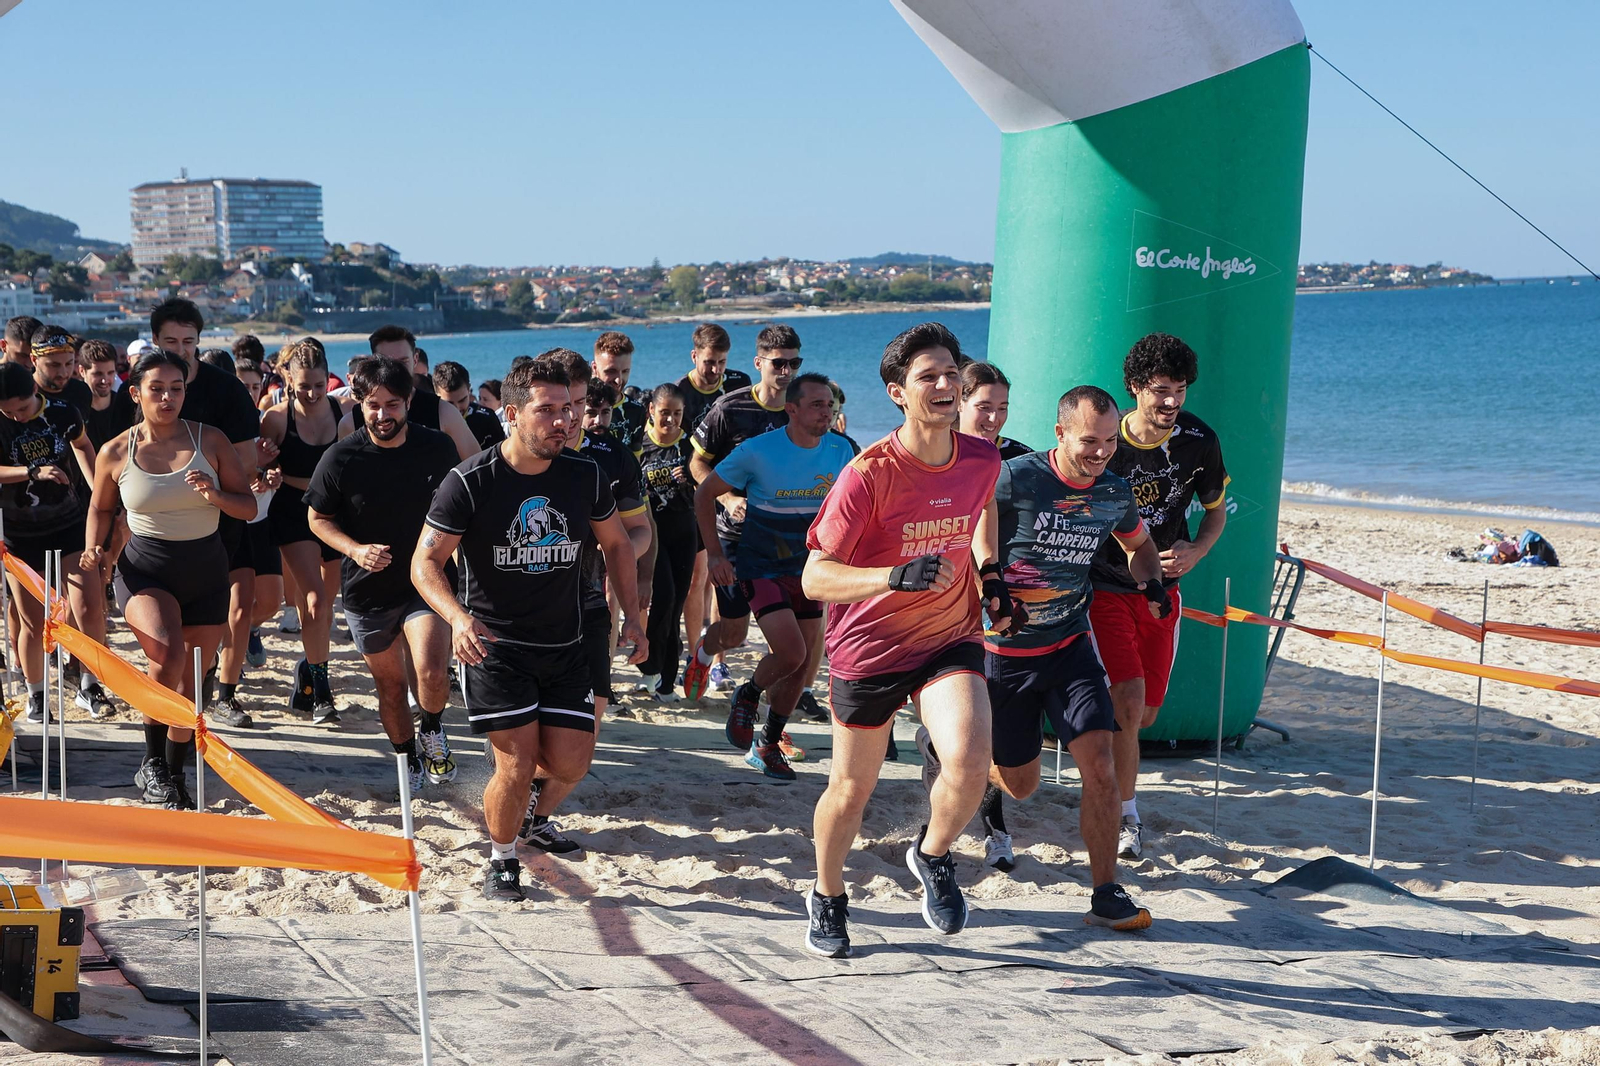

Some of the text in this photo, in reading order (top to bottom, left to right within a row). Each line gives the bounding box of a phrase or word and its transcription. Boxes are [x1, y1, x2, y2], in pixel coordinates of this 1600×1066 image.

[1135, 246, 1257, 280] El Corte Inglés
[20, 438, 48, 454] BOOT
[25, 446, 50, 461] CAMP
[1130, 474, 1153, 487] SAFIO
[1132, 480, 1159, 498] OOT
[1135, 493, 1160, 507] AMP
[901, 514, 971, 541] SUNSET
[1071, 524, 1101, 535] seguros
[900, 536, 954, 557] RACE
[1036, 530, 1100, 551] CARREIRA
[495, 543, 579, 565] GLADIATOR
[1031, 544, 1058, 557] PRAIA
[1054, 548, 1095, 565] SAMIL
[528, 563, 549, 572] RACE
[47, 958, 63, 975] 14
